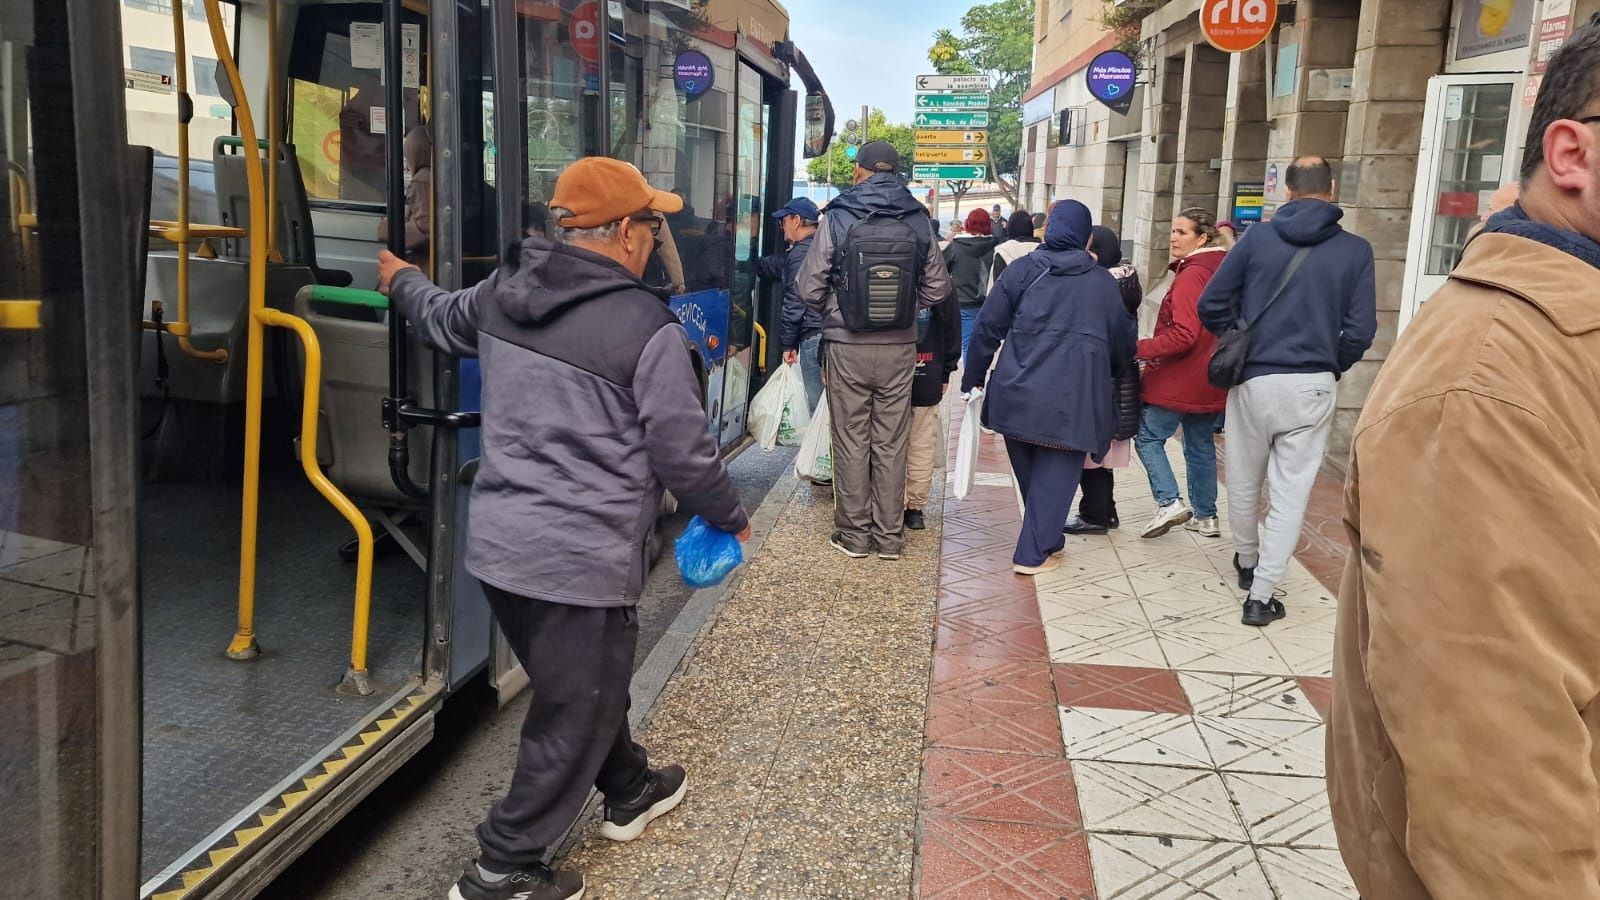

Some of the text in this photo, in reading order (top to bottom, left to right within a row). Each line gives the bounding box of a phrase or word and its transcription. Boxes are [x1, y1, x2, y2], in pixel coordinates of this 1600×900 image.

[1210, 0, 1267, 24] ria
[1210, 28, 1235, 36] Money
[1541, 20, 1567, 33] Alarma
